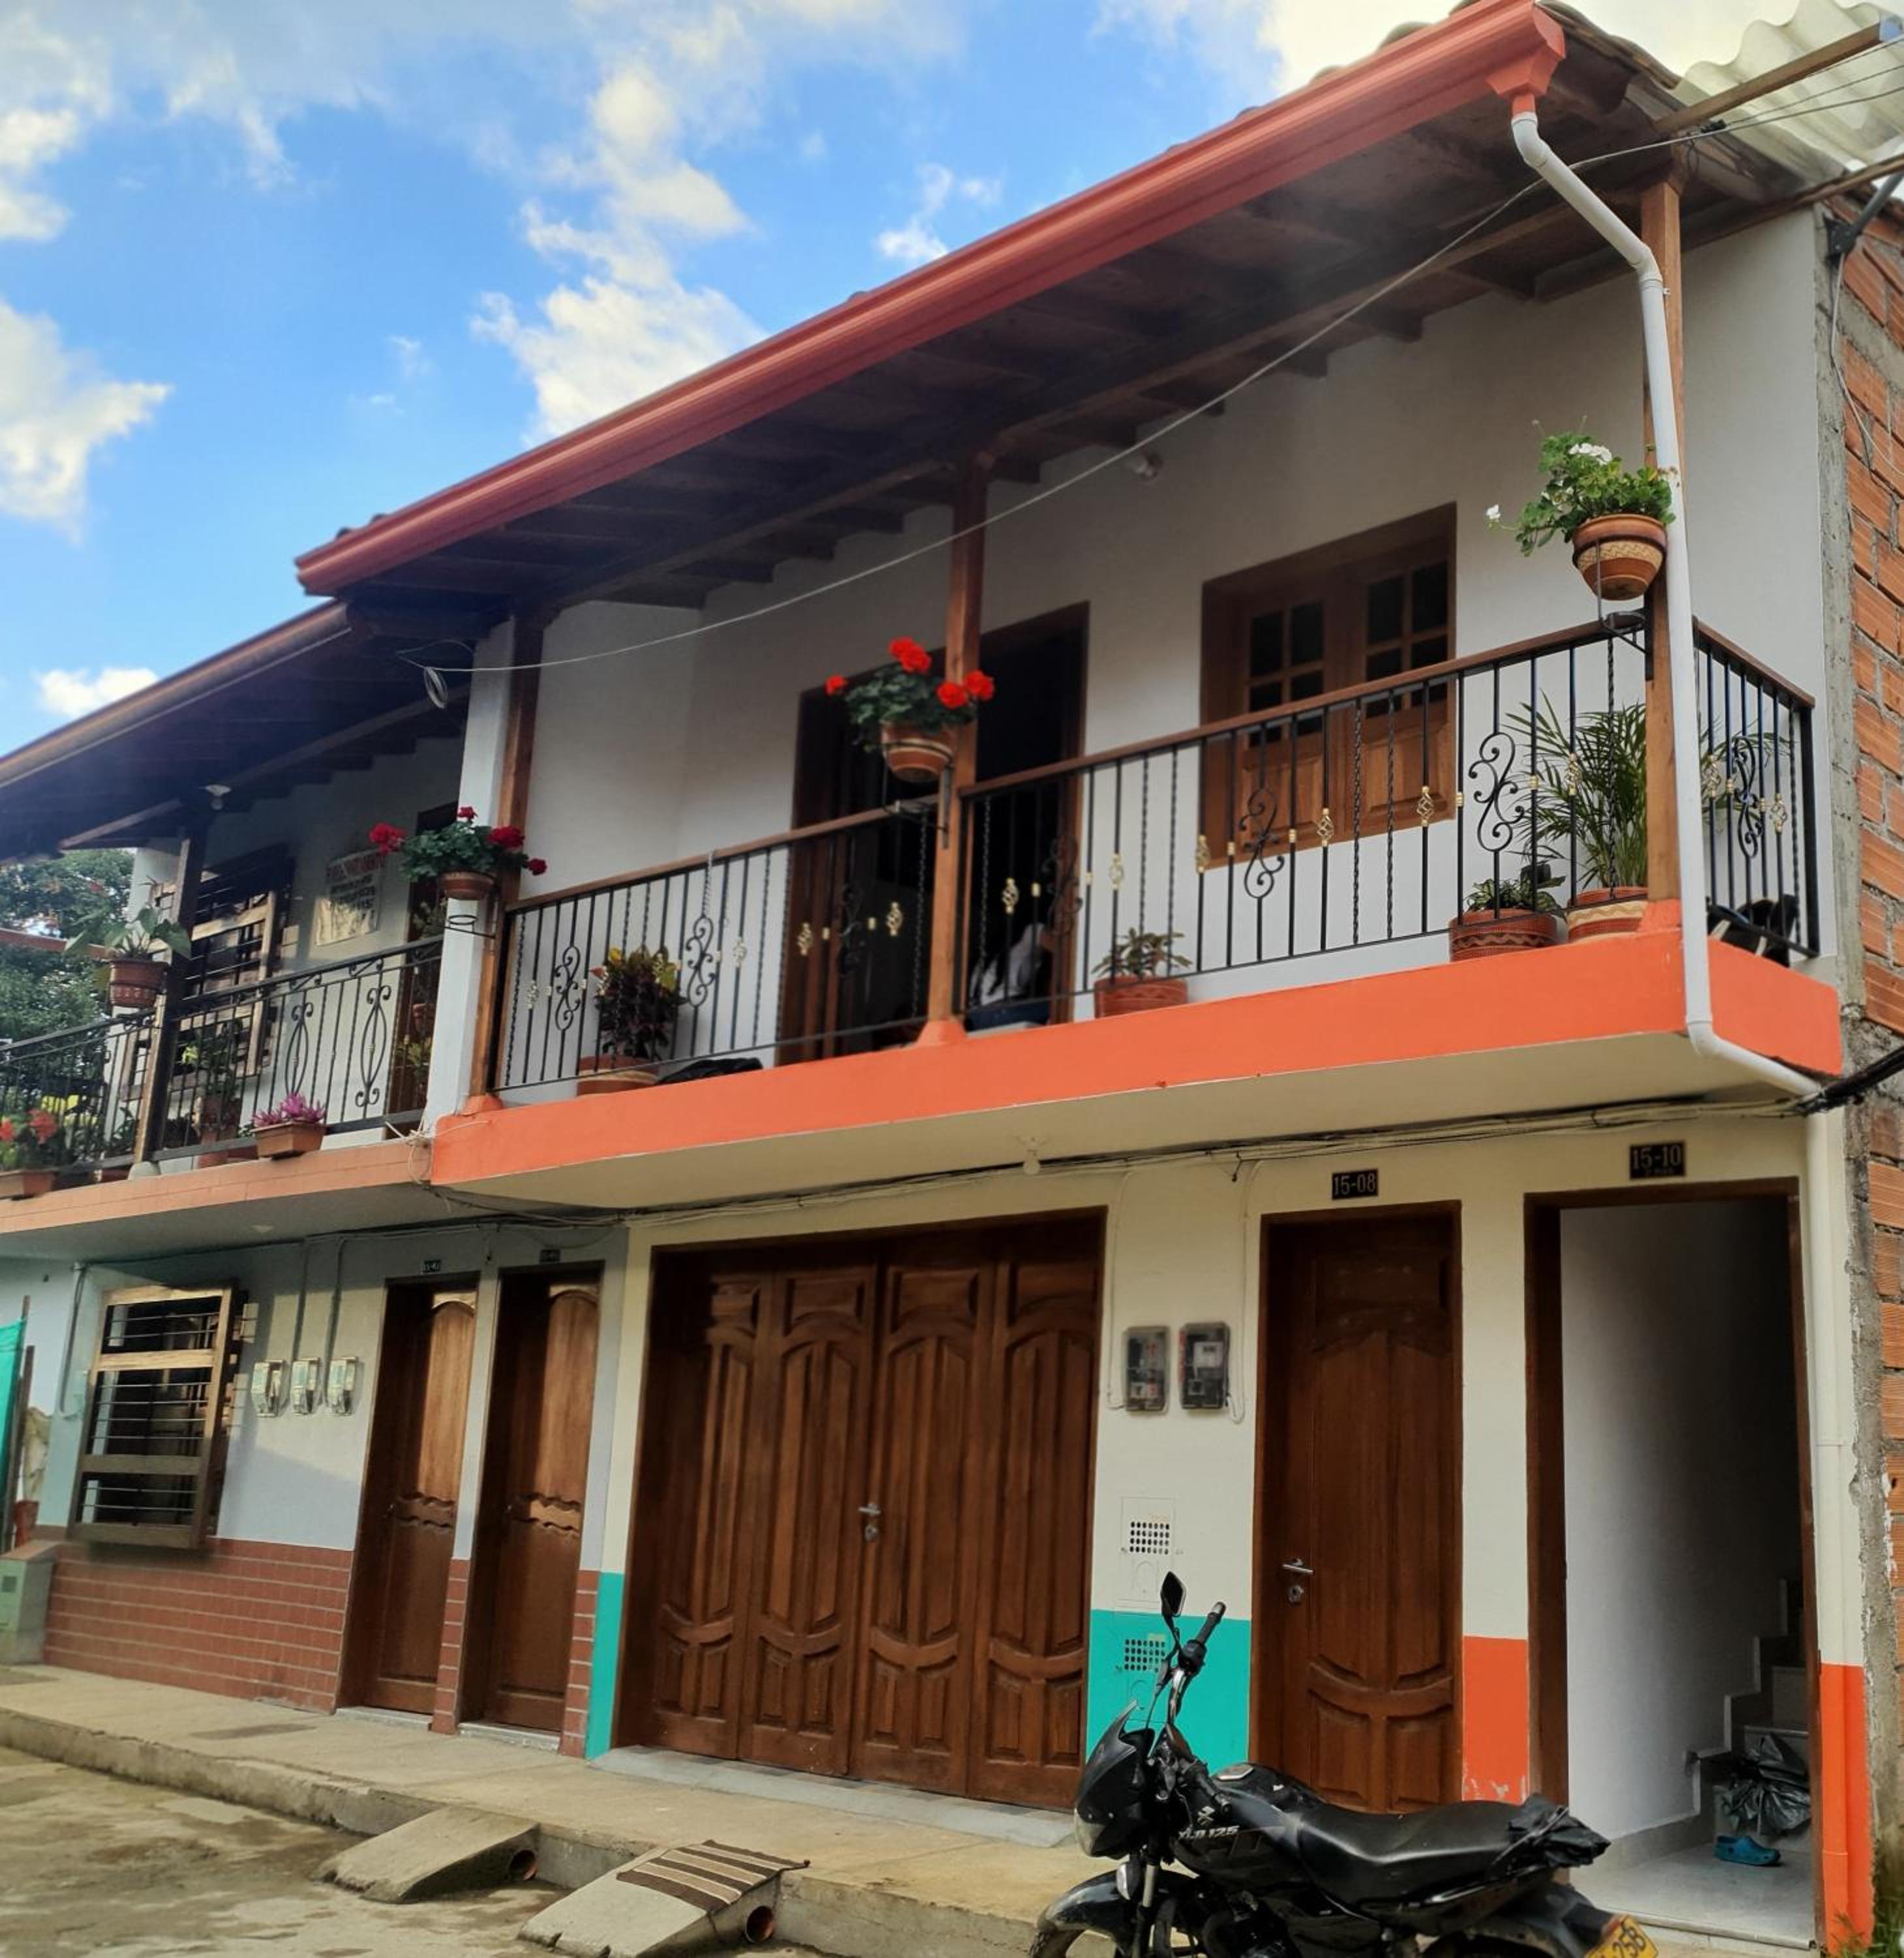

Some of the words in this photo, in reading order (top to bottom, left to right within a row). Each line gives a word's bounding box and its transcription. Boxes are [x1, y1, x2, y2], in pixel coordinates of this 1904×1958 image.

[1633, 1144, 1682, 1172] 15-10
[1334, 1172, 1376, 1196] 15-08
[1208, 1826, 1240, 1838] 125
